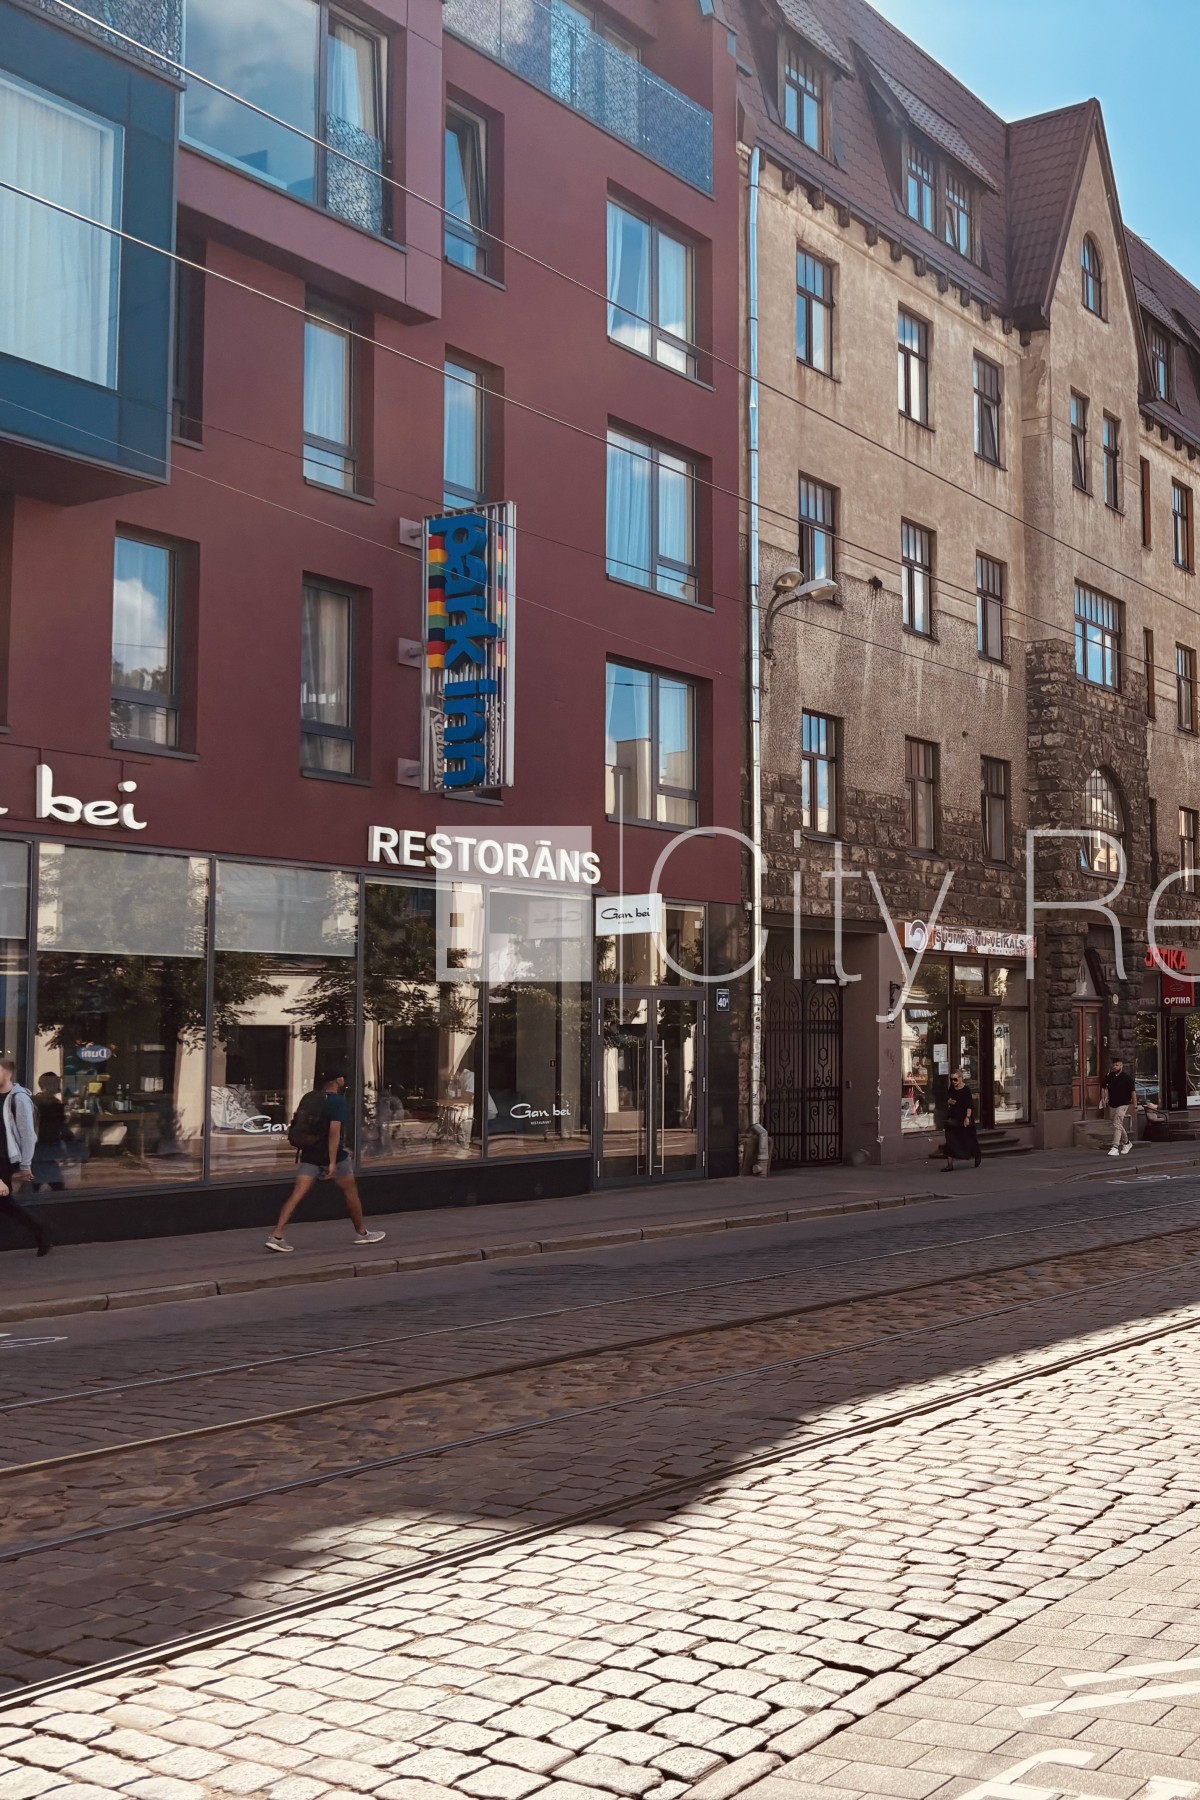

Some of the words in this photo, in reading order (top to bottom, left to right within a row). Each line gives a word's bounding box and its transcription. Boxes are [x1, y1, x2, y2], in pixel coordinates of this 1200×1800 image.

[429, 512, 498, 672] park
[444, 678, 498, 787] inn
[36, 763, 148, 830] bei
[368, 825, 602, 885] RESTORĀNS
[601, 907, 633, 920] Gan
[635, 907, 651, 918] bei
[989, 937, 1025, 950] VEIKALS
[1163, 996, 1191, 1005] OPTIKA
[510, 1103, 549, 1119] Gan
[552, 1103, 571, 1116] bei
